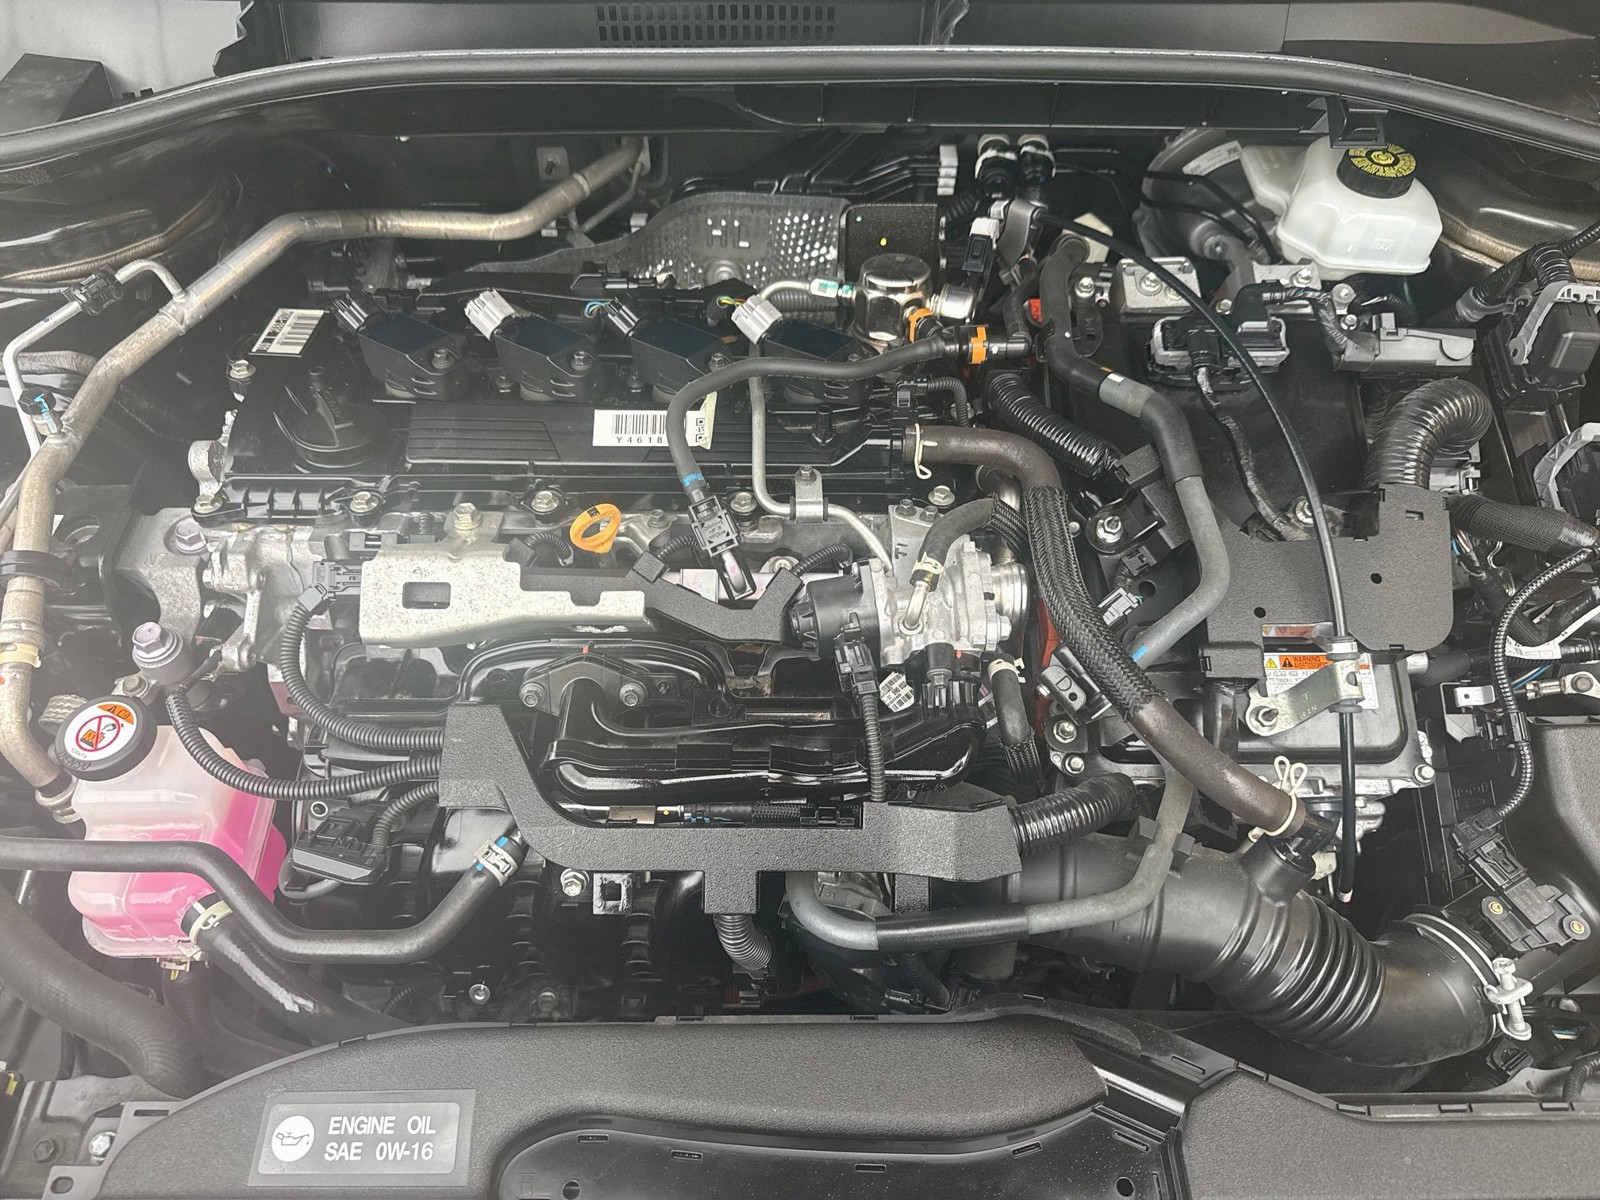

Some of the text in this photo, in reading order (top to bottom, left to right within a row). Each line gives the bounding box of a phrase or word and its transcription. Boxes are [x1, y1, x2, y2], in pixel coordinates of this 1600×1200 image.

[328, 1115, 437, 1135] ENGINE OIL
[324, 1141, 434, 1161] SAE 0W-16
